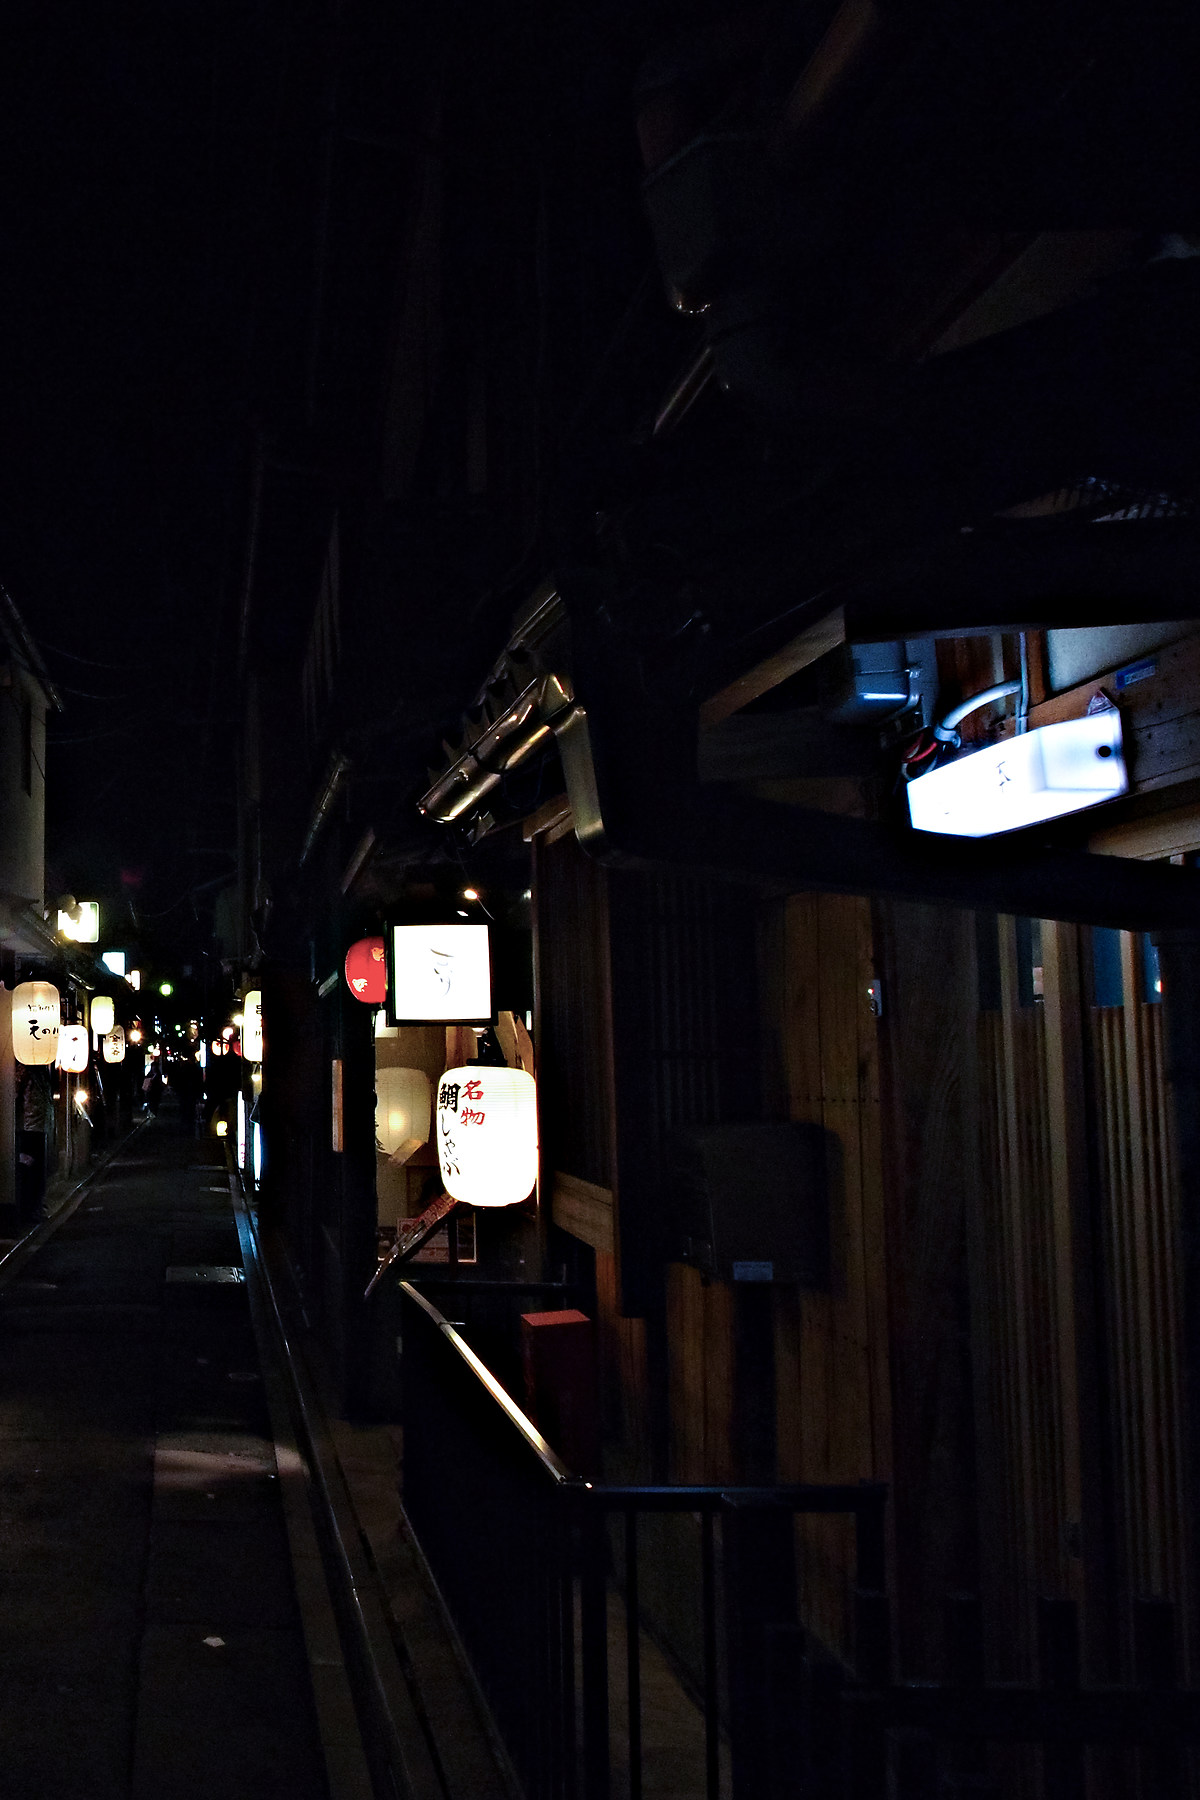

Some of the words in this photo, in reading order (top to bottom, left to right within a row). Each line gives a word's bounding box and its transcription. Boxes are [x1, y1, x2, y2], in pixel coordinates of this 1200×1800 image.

[438, 1082, 461, 1176] 鯛しゃぶ
[460, 1080, 486, 1126] 名物
